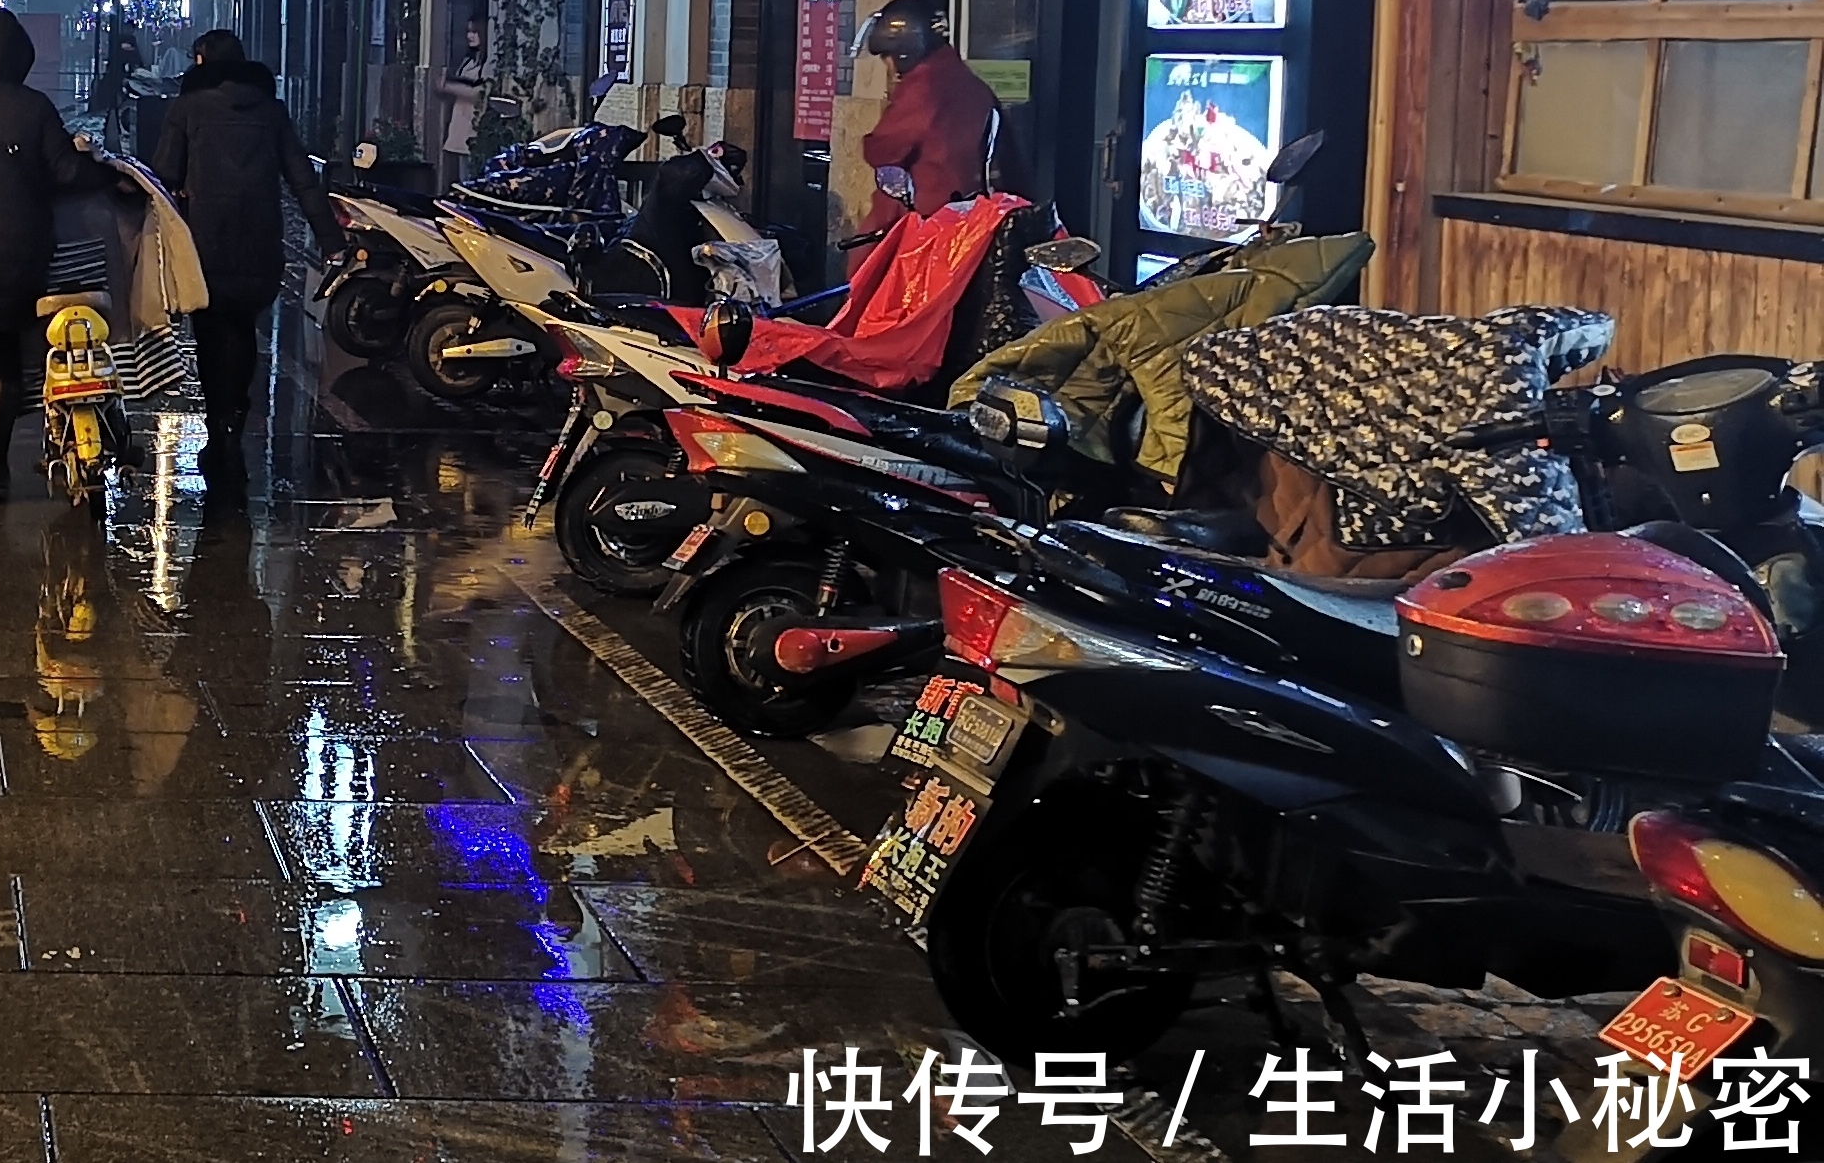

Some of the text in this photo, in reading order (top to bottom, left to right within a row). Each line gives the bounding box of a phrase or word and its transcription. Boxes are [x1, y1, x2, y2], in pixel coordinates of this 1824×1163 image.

[906, 776, 978, 856] 新的
[883, 826, 948, 894] 长跑王
